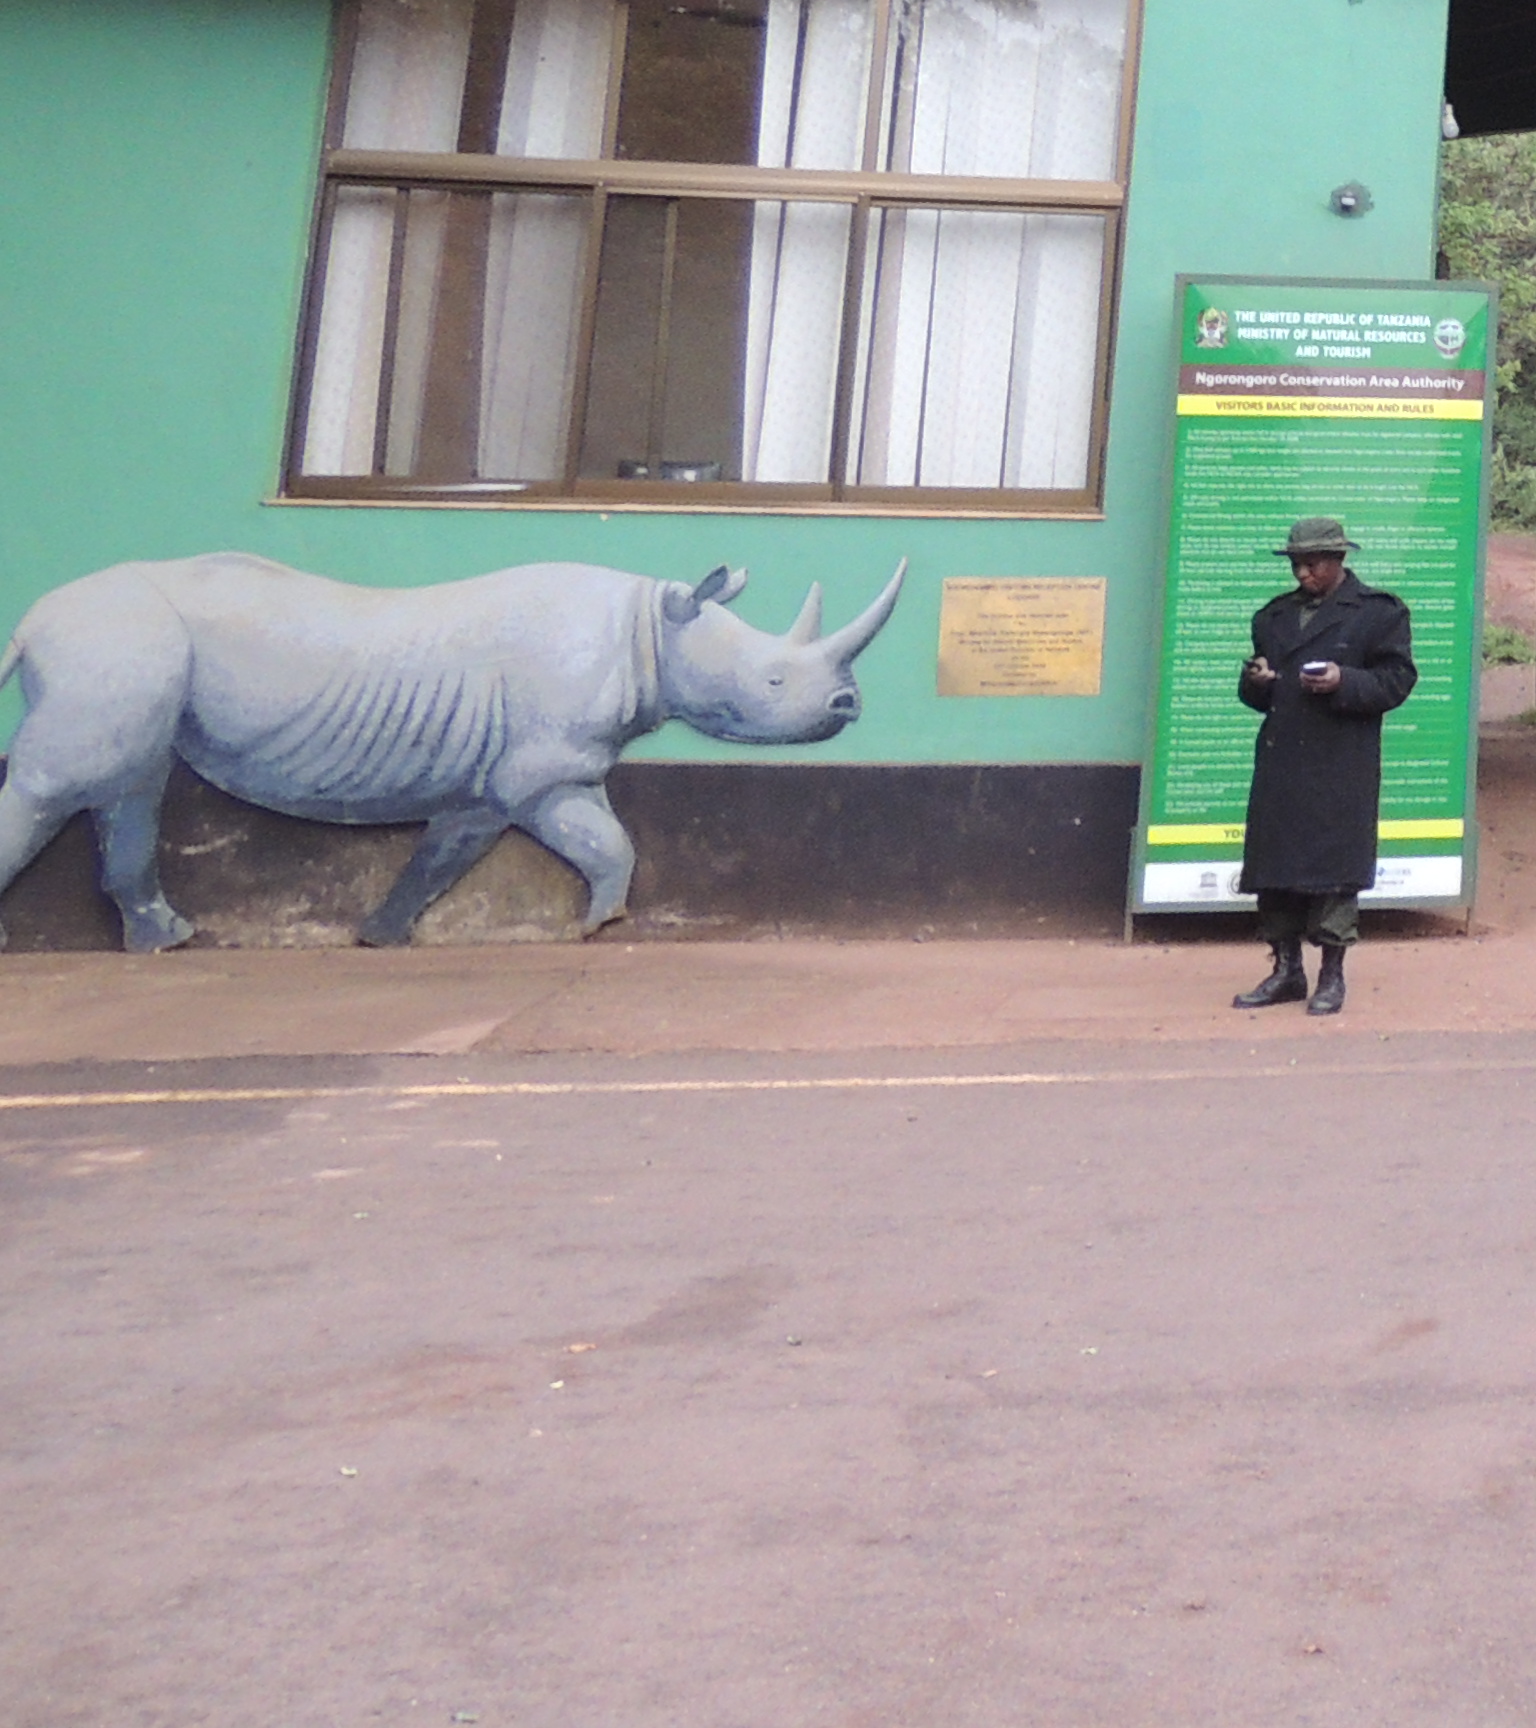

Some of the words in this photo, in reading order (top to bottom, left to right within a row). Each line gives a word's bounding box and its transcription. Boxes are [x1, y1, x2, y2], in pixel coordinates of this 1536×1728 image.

[1234, 310, 1257, 323] THE
[1259, 310, 1300, 324] UNITED
[1303, 312, 1355, 326] REPUBLIC
[1358, 314, 1375, 326] OF
[1377, 315, 1431, 328] TANZANIA
[1237, 327, 1290, 341] MINISTRY
[1293, 328, 1308, 341] OF
[1311, 329, 1361, 342] NATURAL
[1364, 330, 1426, 344] RESOURCES
[1295, 345, 1320, 358] AND
[1322, 346, 1371, 359] TOURISM
[1195, 372, 1277, 389] Ngorongoro
[1279, 373, 1366, 388] Conservation
[1369, 375, 1399, 388] Area
[1402, 375, 1465, 392] Authority
[1215, 400, 1264, 412] VISITORS
[1266, 401, 1297, 412] BASIC
[1299, 402, 1374, 414] INFORMATION
[1377, 403, 1399, 414] AND
[1402, 403, 1435, 414] RULES
